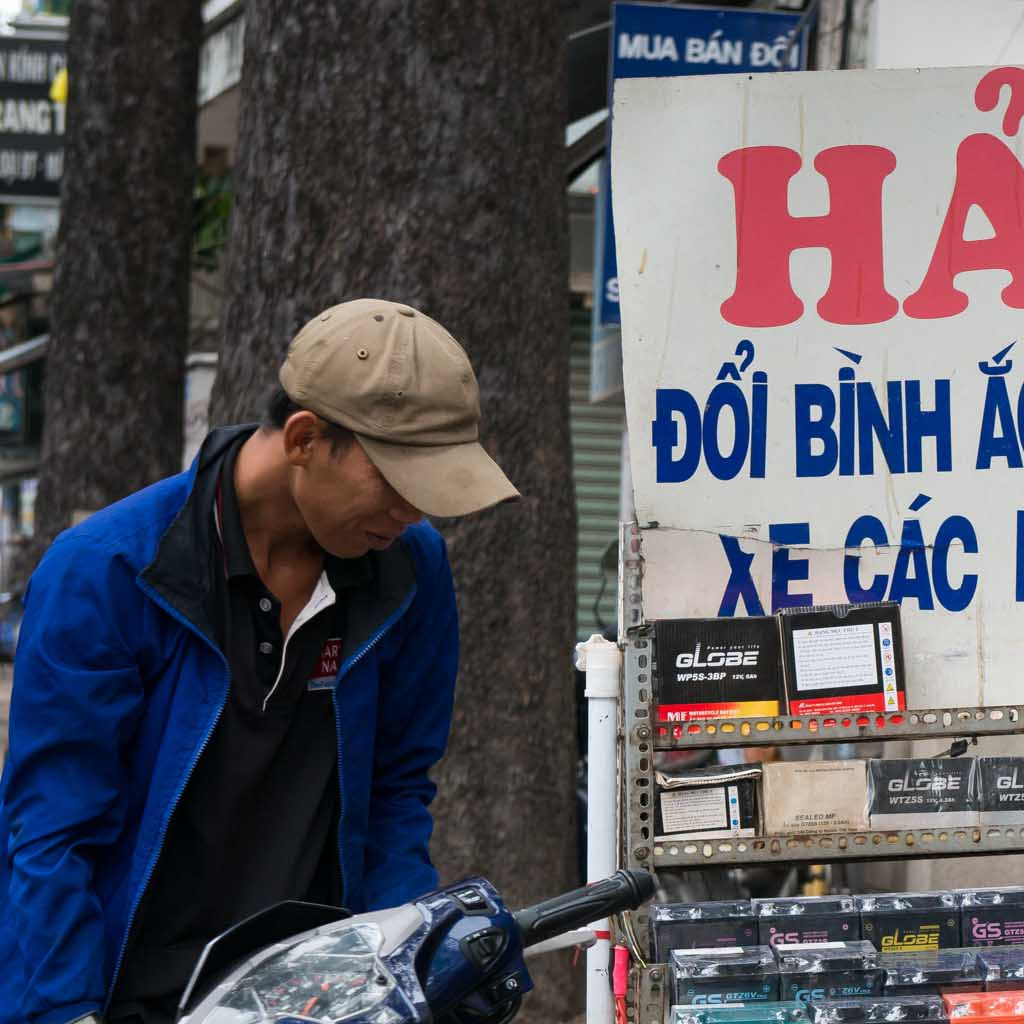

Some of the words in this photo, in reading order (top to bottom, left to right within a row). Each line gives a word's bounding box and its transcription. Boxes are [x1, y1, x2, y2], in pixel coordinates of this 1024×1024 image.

[618, 33, 678, 61] MUA
[684, 29, 742, 65] BÁN
[652, 339, 768, 484] ĐỔI
[794, 346, 953, 479] BÌNH
[717, 522, 813, 617] XE
[843, 493, 978, 612] CÁC
[675, 641, 760, 668] GLOBE
[677, 672, 727, 682] WP5S-3BP
[888, 768, 961, 792] GLOBE
[889, 795, 924, 805] WTZ5S
[770, 931, 800, 945] GS
[881, 928, 940, 946] GLOBE
[972, 922, 1002, 938] GS
[795, 988, 825, 1002] GS
